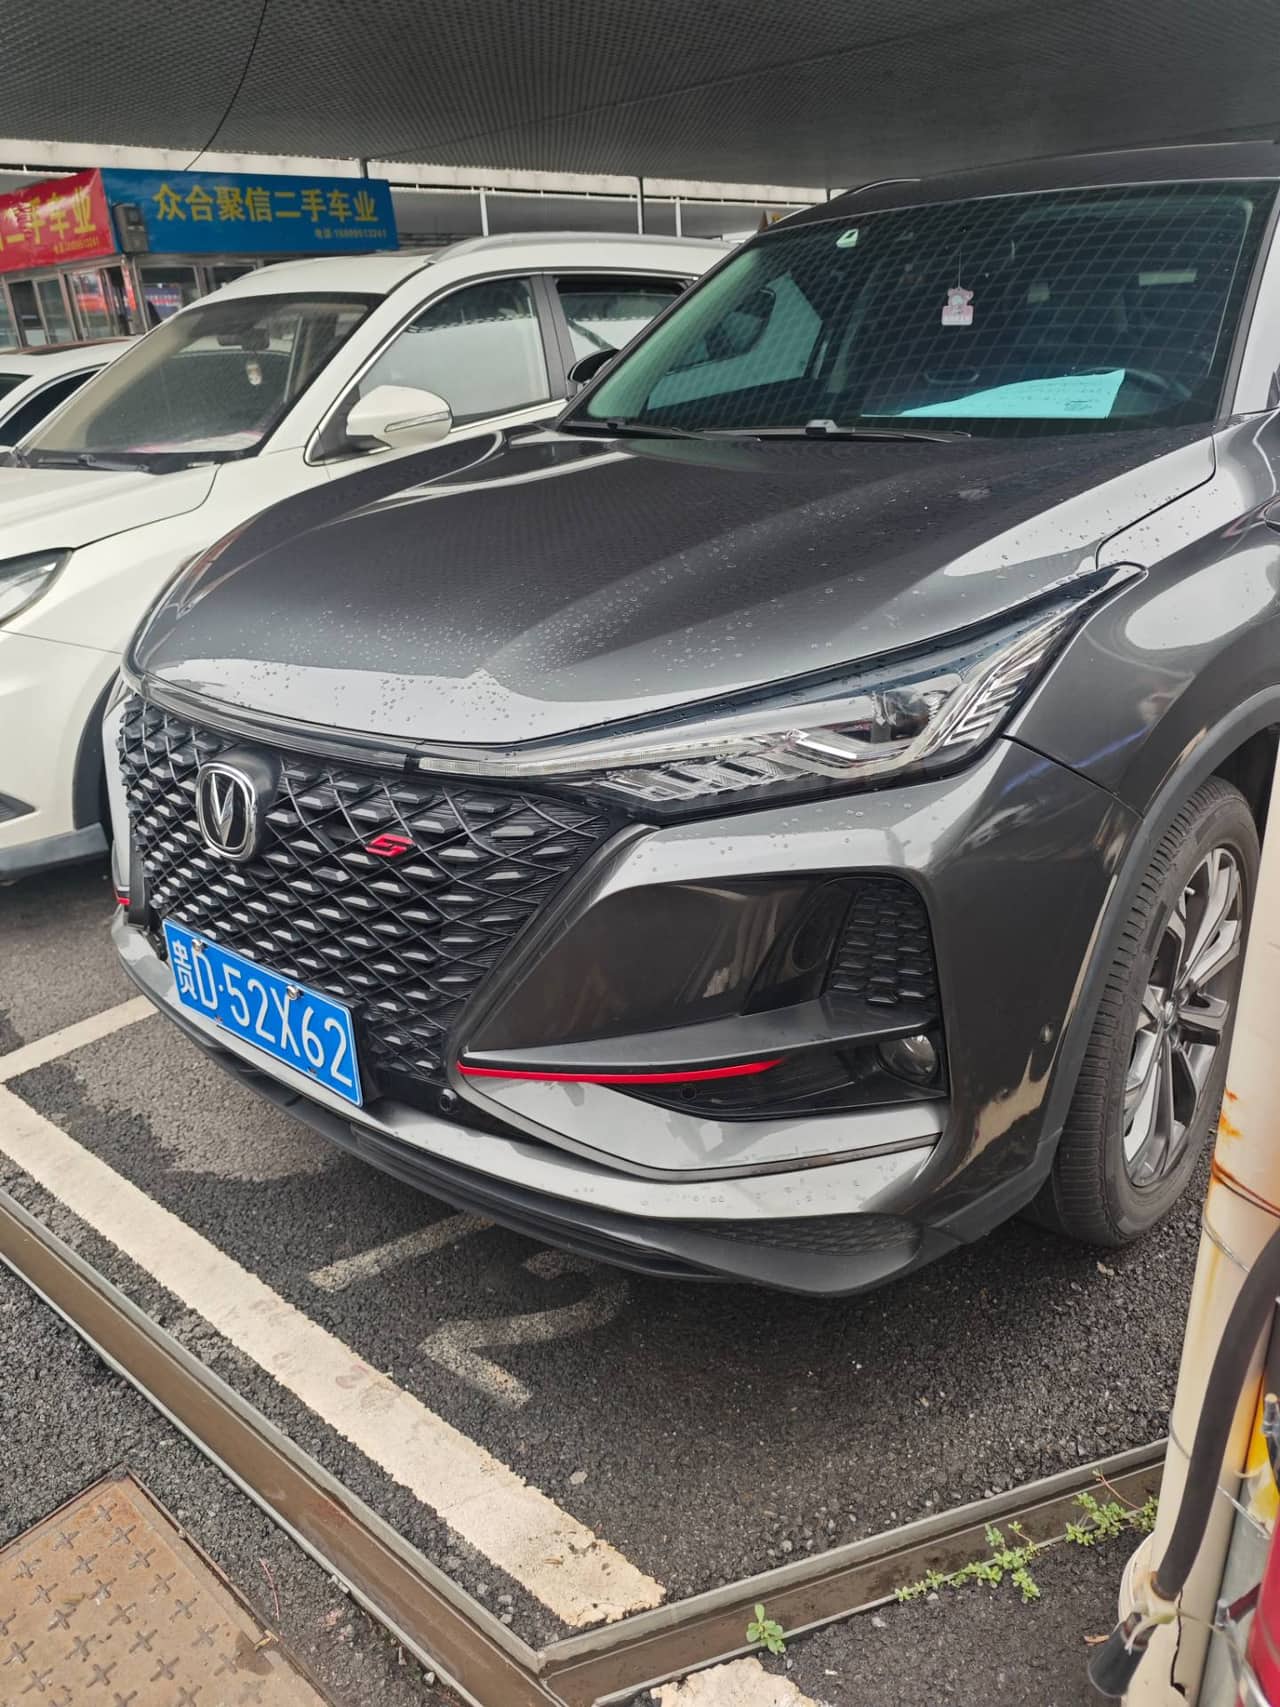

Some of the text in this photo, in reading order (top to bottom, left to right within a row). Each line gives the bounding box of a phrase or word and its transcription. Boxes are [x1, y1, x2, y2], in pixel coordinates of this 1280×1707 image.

[0, 186, 96, 251] 二手车业
[153, 183, 379, 222] 众合聚信二手车业
